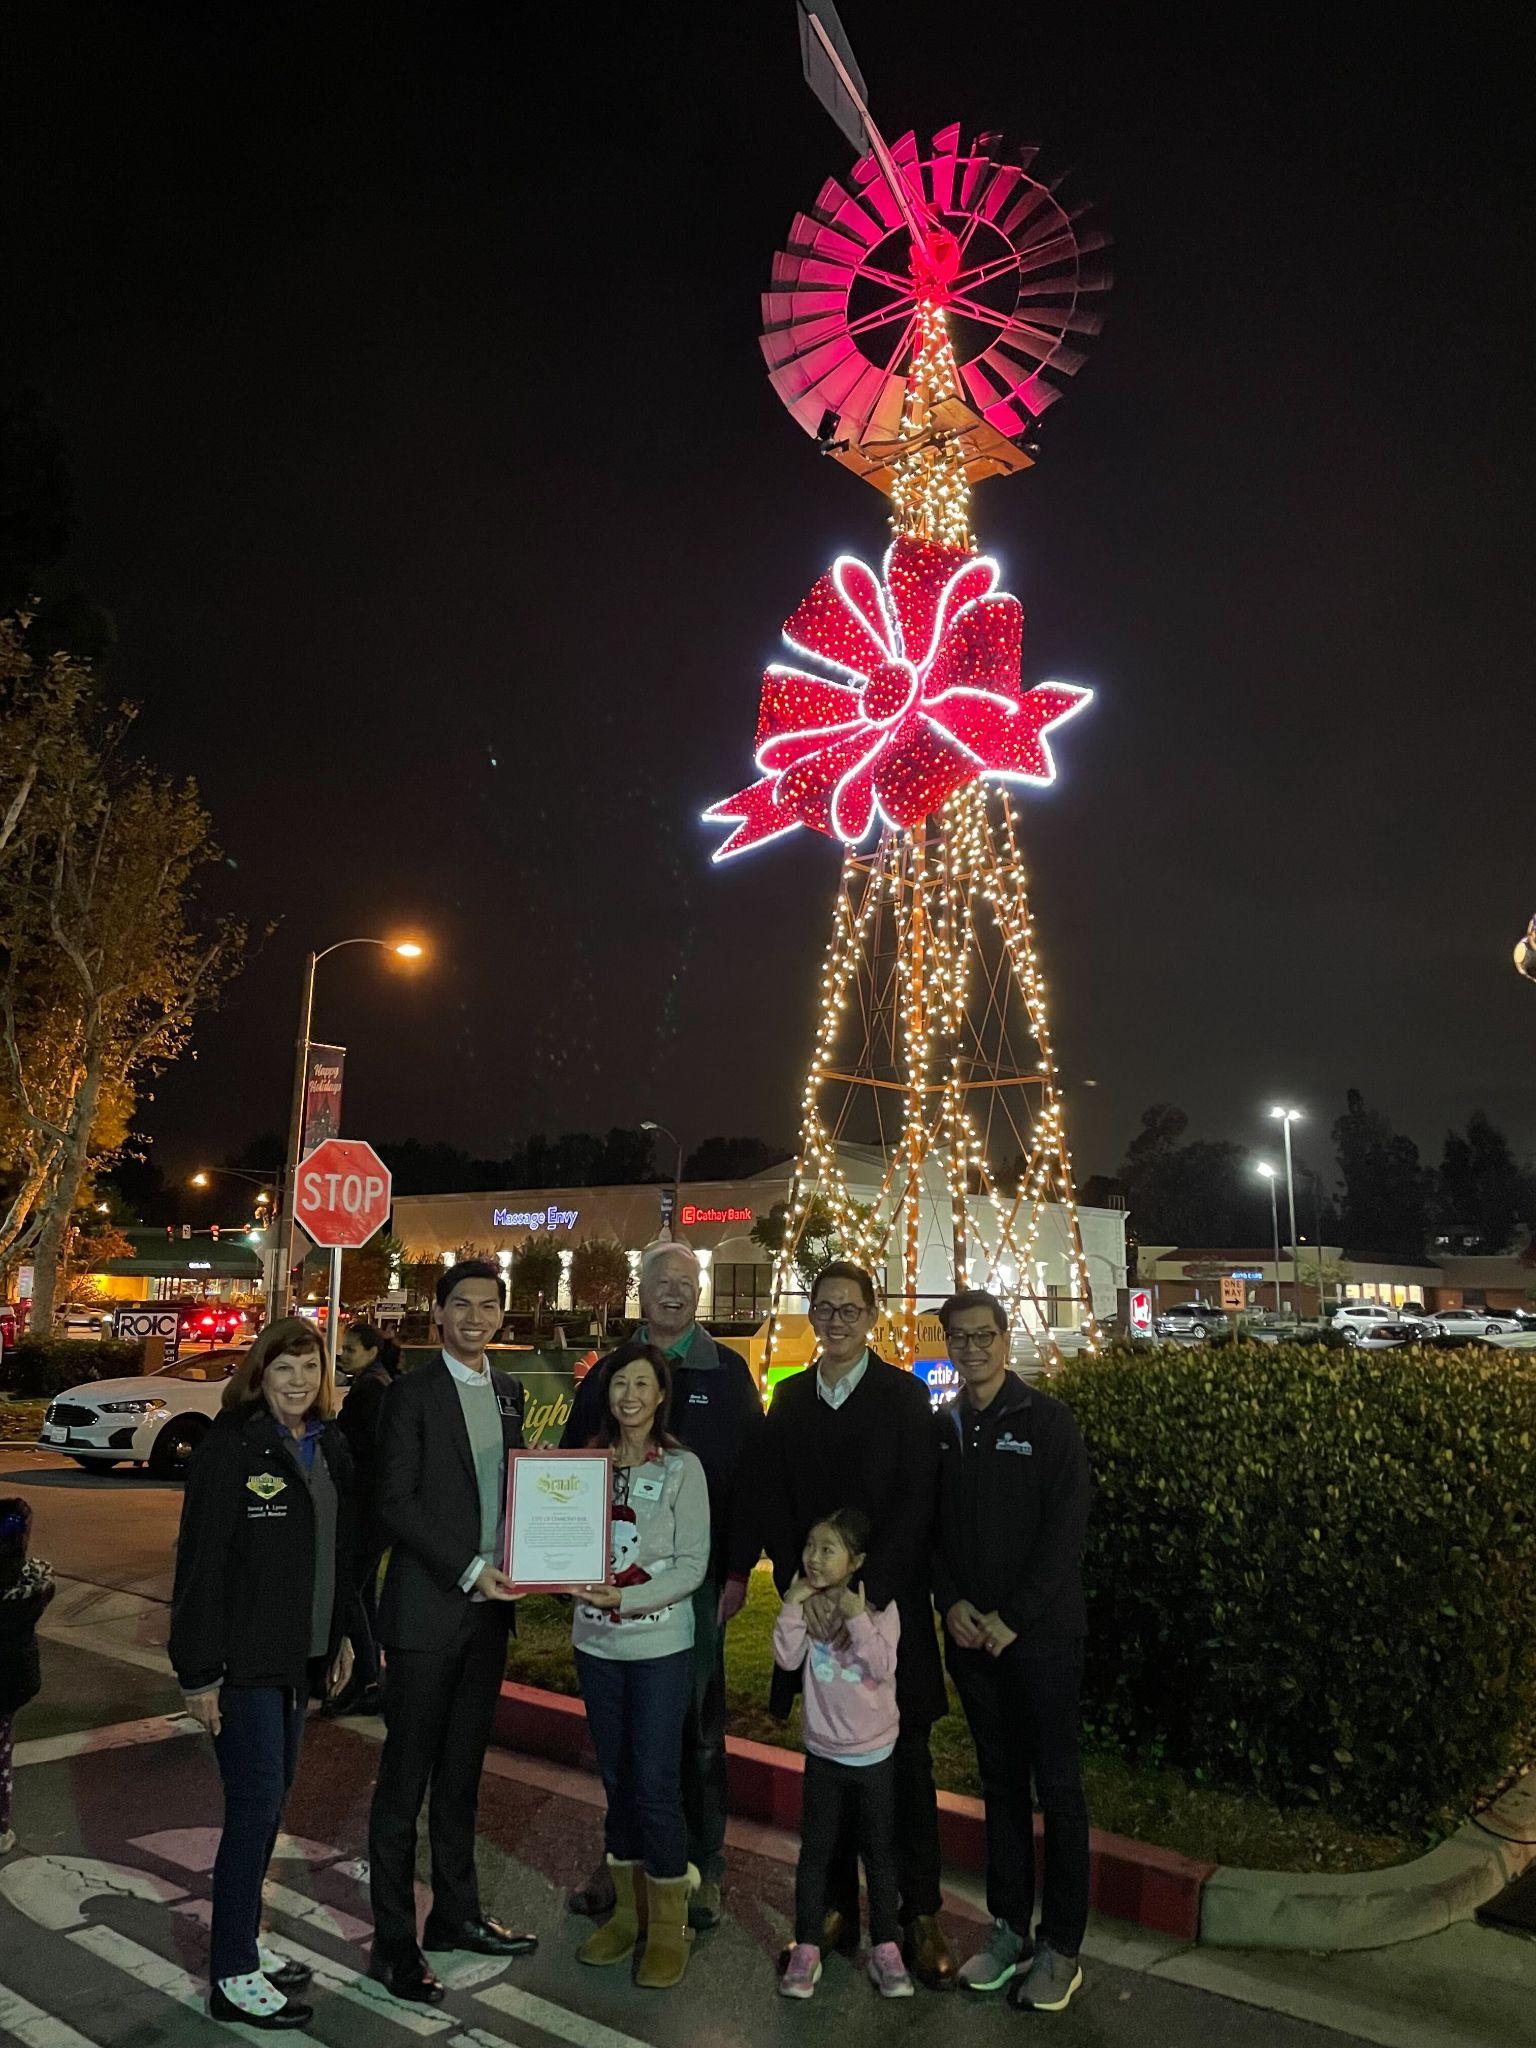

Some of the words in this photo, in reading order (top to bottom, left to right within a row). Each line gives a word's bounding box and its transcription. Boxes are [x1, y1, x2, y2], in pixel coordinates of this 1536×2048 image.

[313, 1063, 339, 1079] Happy
[309, 1079, 342, 1096] Holidays
[302, 1172, 384, 1213] STOP
[493, 1207, 546, 1230] Massage
[547, 1205, 578, 1230] Envy
[696, 1209, 727, 1223] Cathay
[728, 1208, 752, 1221] Bank
[1224, 1280, 1241, 1289] ONE
[1224, 1289, 1242, 1297] WAY
[121, 1315, 176, 1336] ROIC
